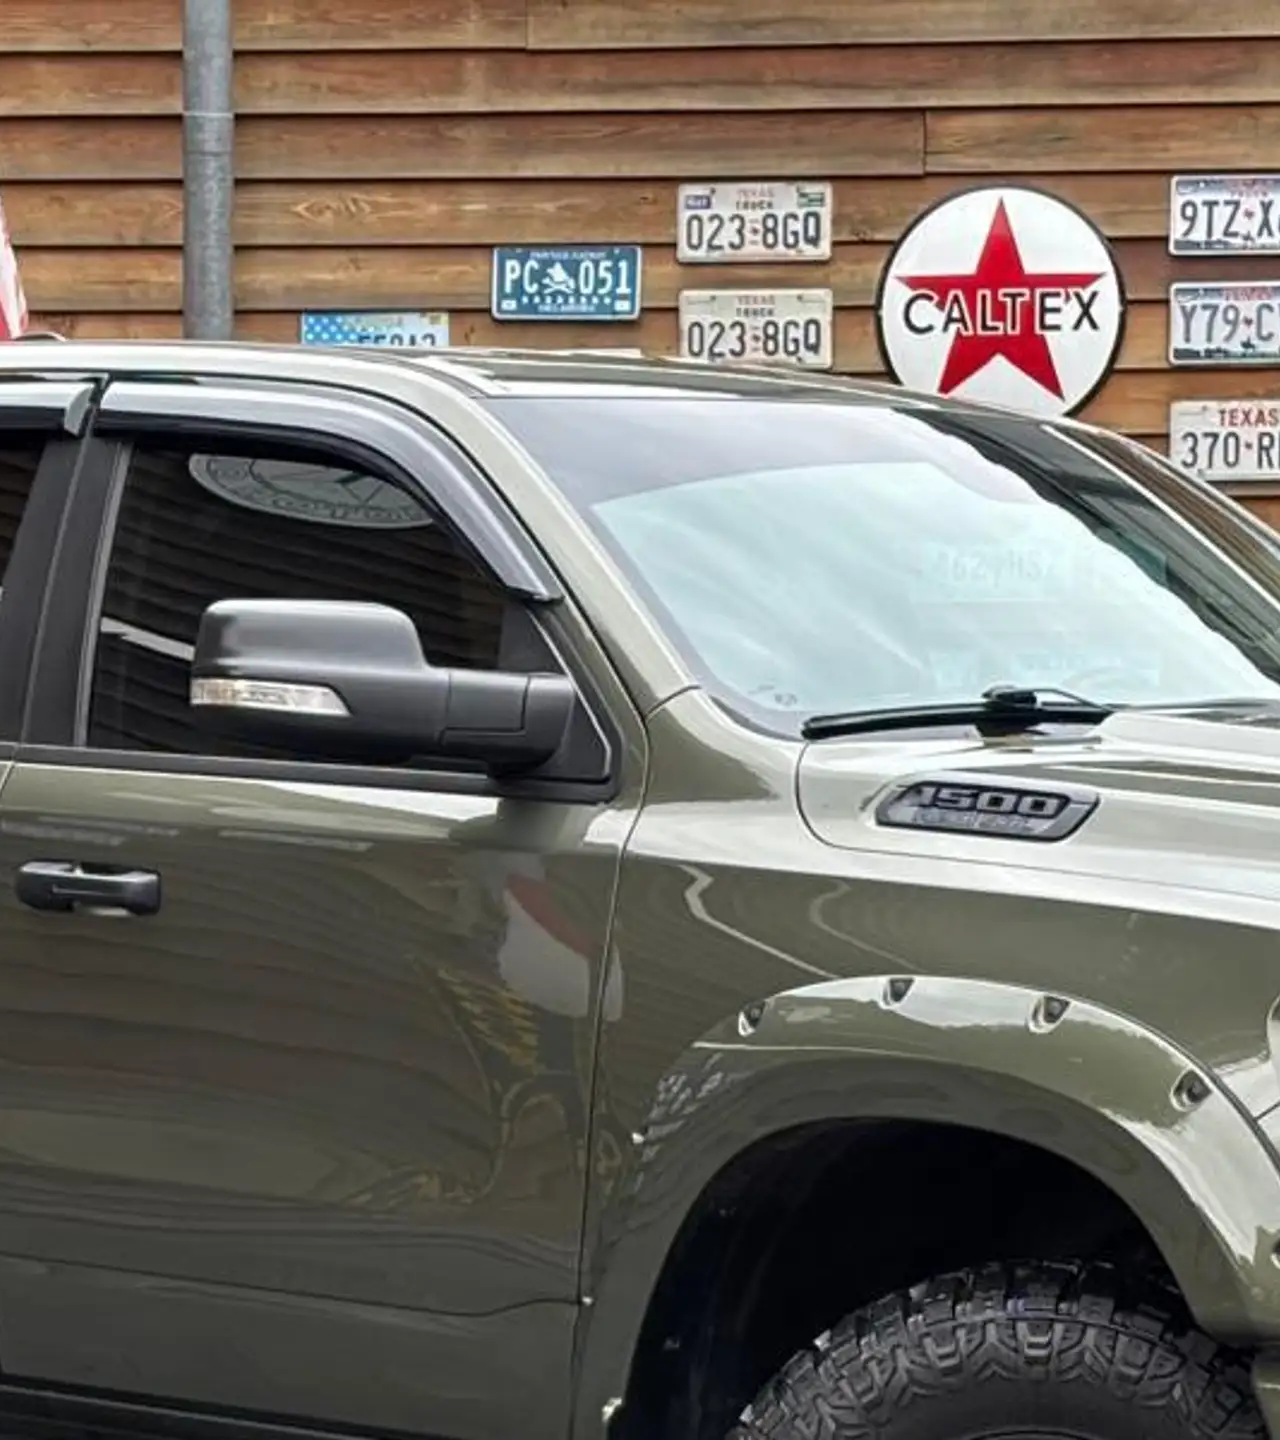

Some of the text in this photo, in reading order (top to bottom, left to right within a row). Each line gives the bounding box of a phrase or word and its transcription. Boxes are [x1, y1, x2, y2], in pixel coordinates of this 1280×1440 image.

[686, 212, 821, 251] 023 8GQ
[1180, 200, 1241, 239] 9TZ
[505, 259, 631, 294] PC 051
[902, 290, 1099, 335] CALTEX
[1180, 304, 1239, 343] Y79
[688, 318, 821, 358] 023 8GQ
[1220, 408, 1279, 426] TEXAS
[1181, 431, 1240, 468] 370
[903, 785, 1061, 818] 1500
